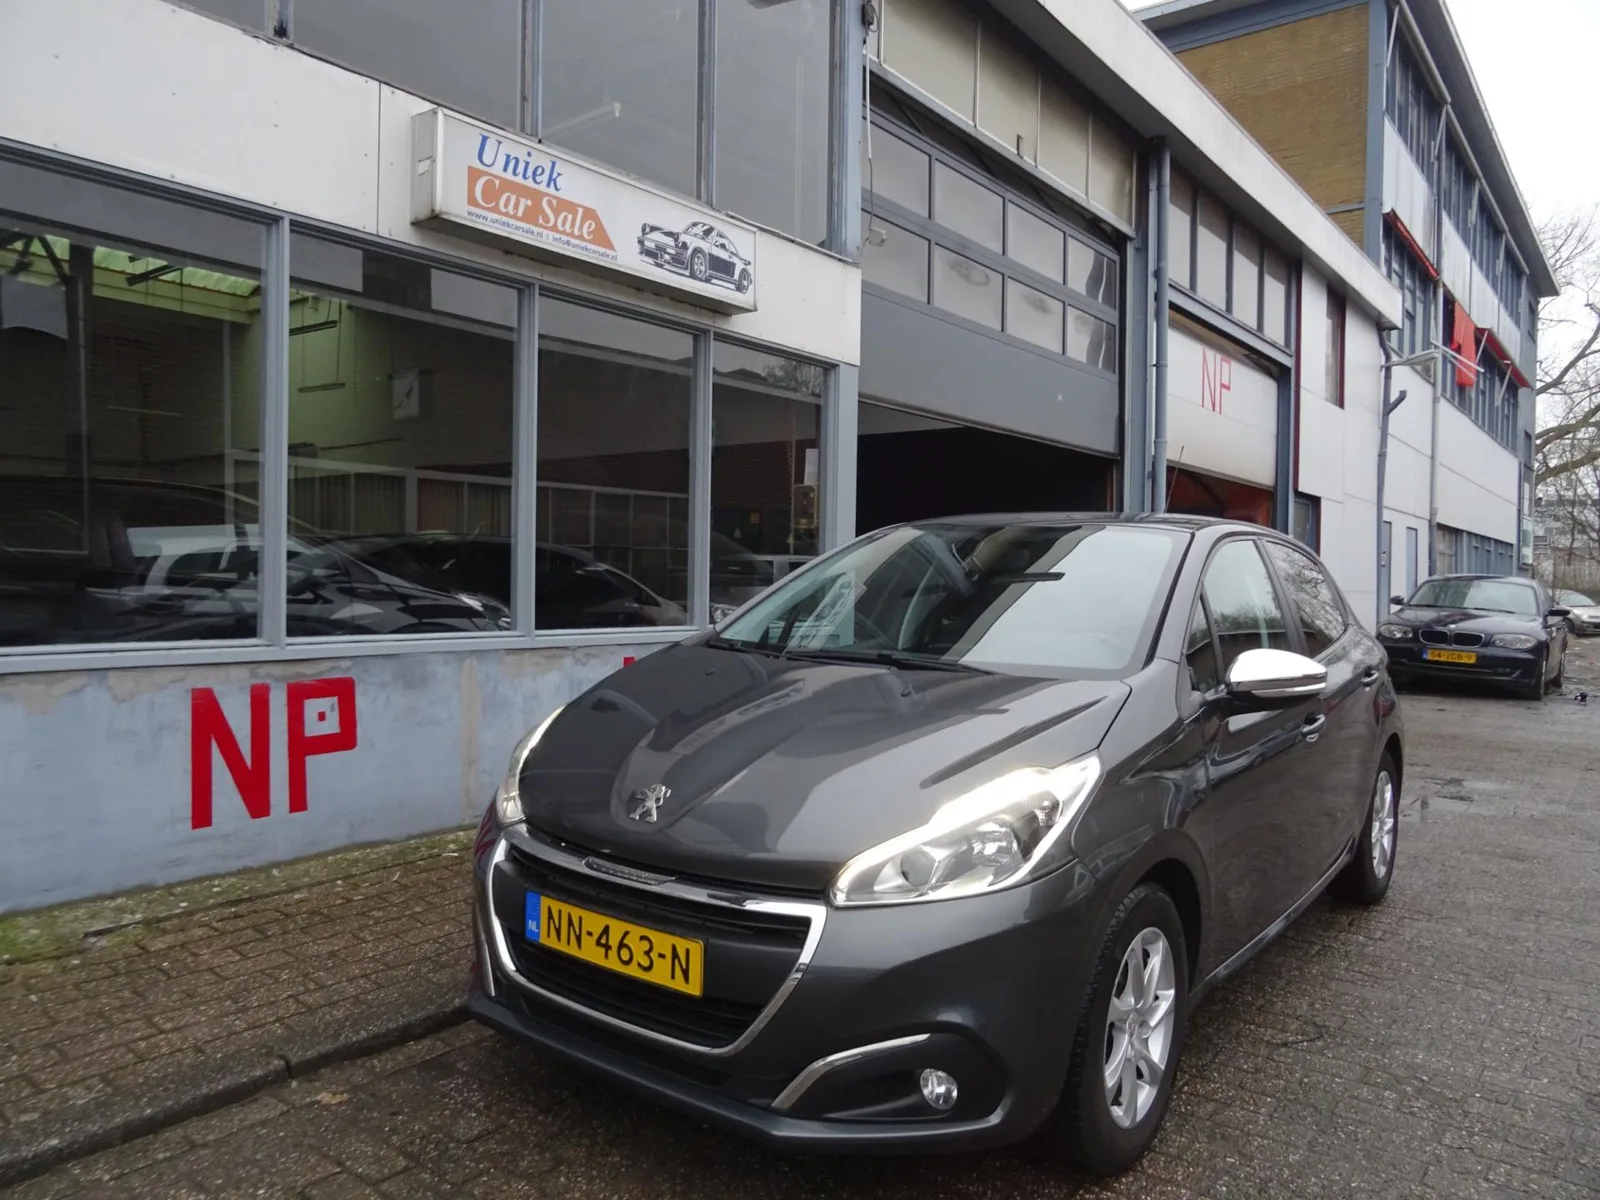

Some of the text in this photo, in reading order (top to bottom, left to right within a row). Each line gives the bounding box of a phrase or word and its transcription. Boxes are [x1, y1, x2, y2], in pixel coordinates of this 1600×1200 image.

[476, 133, 563, 192] Uniek
[466, 209, 618, 261] www.uniekcarsale.nl info@uniekcarsale.nl
[474, 175, 597, 240] Car Sale
[1201, 346, 1232, 415] NP
[190, 676, 358, 830] NP
[528, 904, 691, 985] NL NN-463-N
